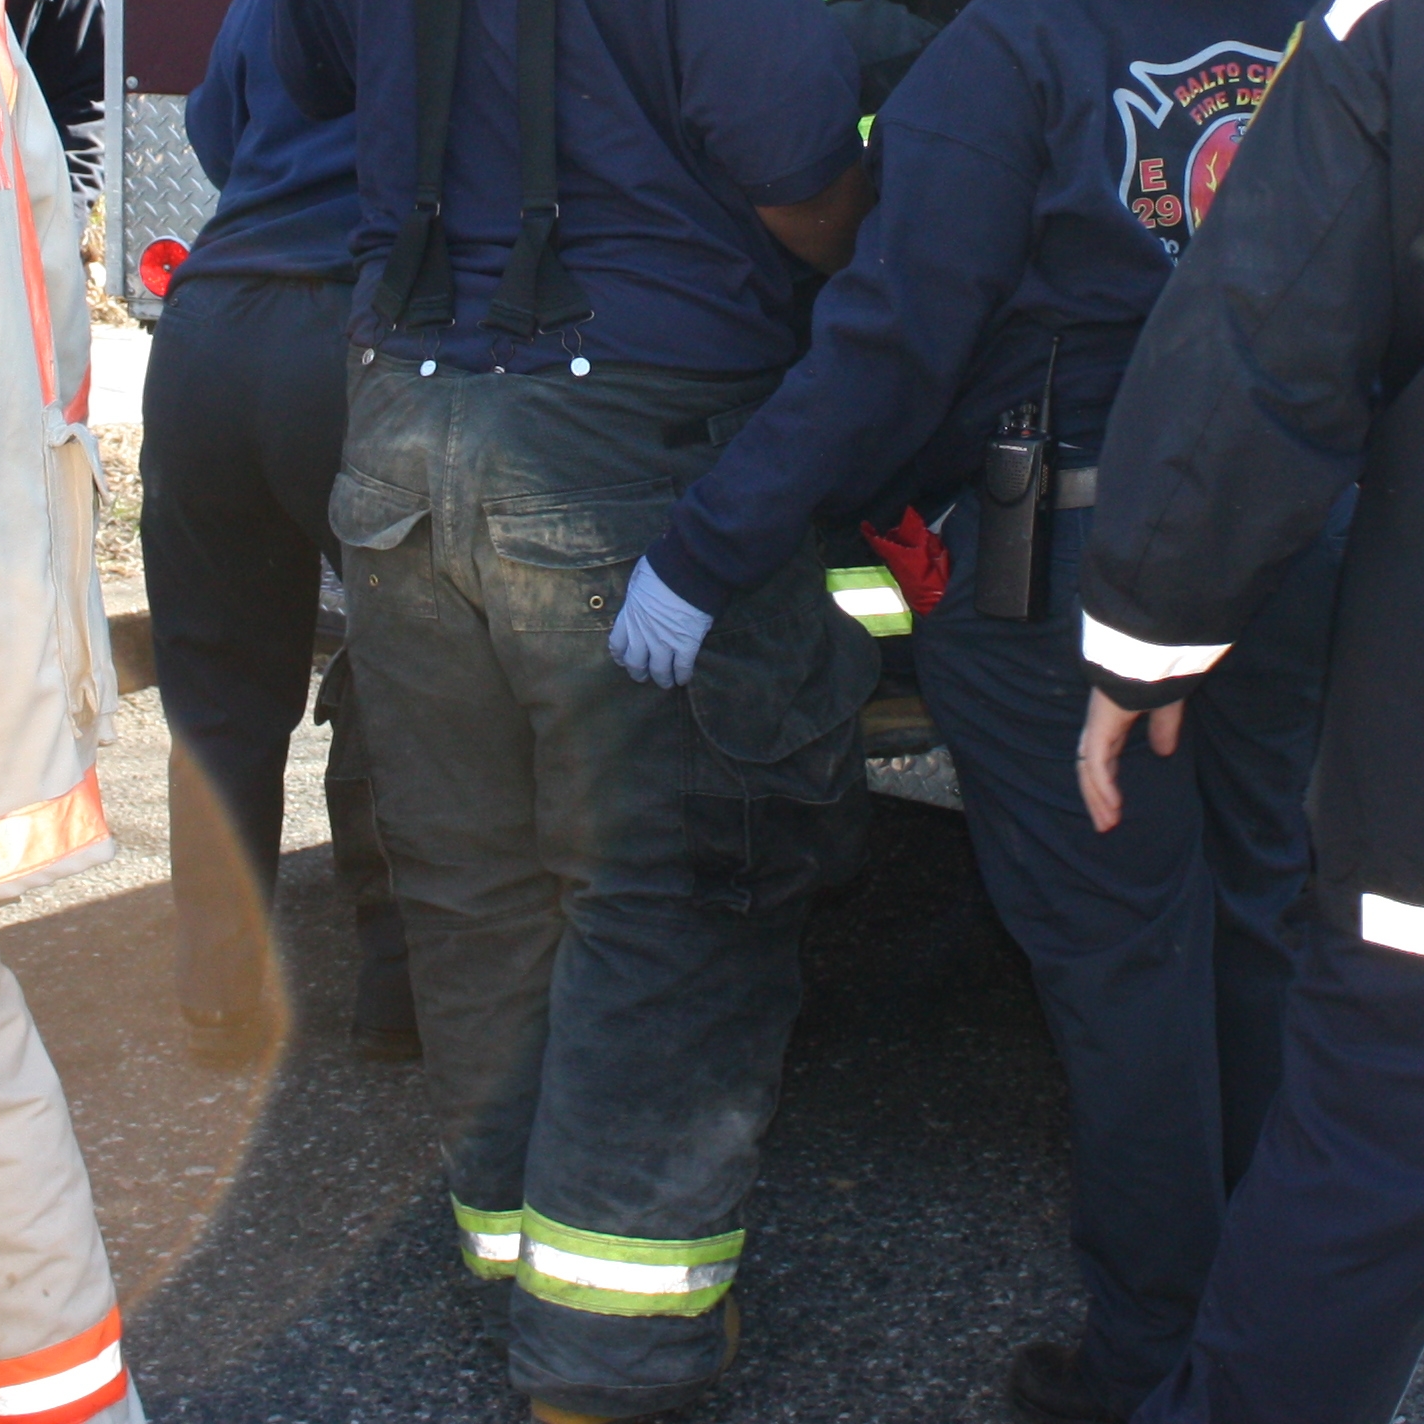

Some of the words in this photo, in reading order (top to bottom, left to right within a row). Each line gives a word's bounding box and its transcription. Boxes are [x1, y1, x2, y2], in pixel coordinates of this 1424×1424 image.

[1247, 64, 1276, 84] CI
[1189, 91, 1230, 126] FIRE
[1236, 88, 1265, 106] DE
[1140, 158, 1167, 192] E
[1132, 195, 1183, 229] 29
